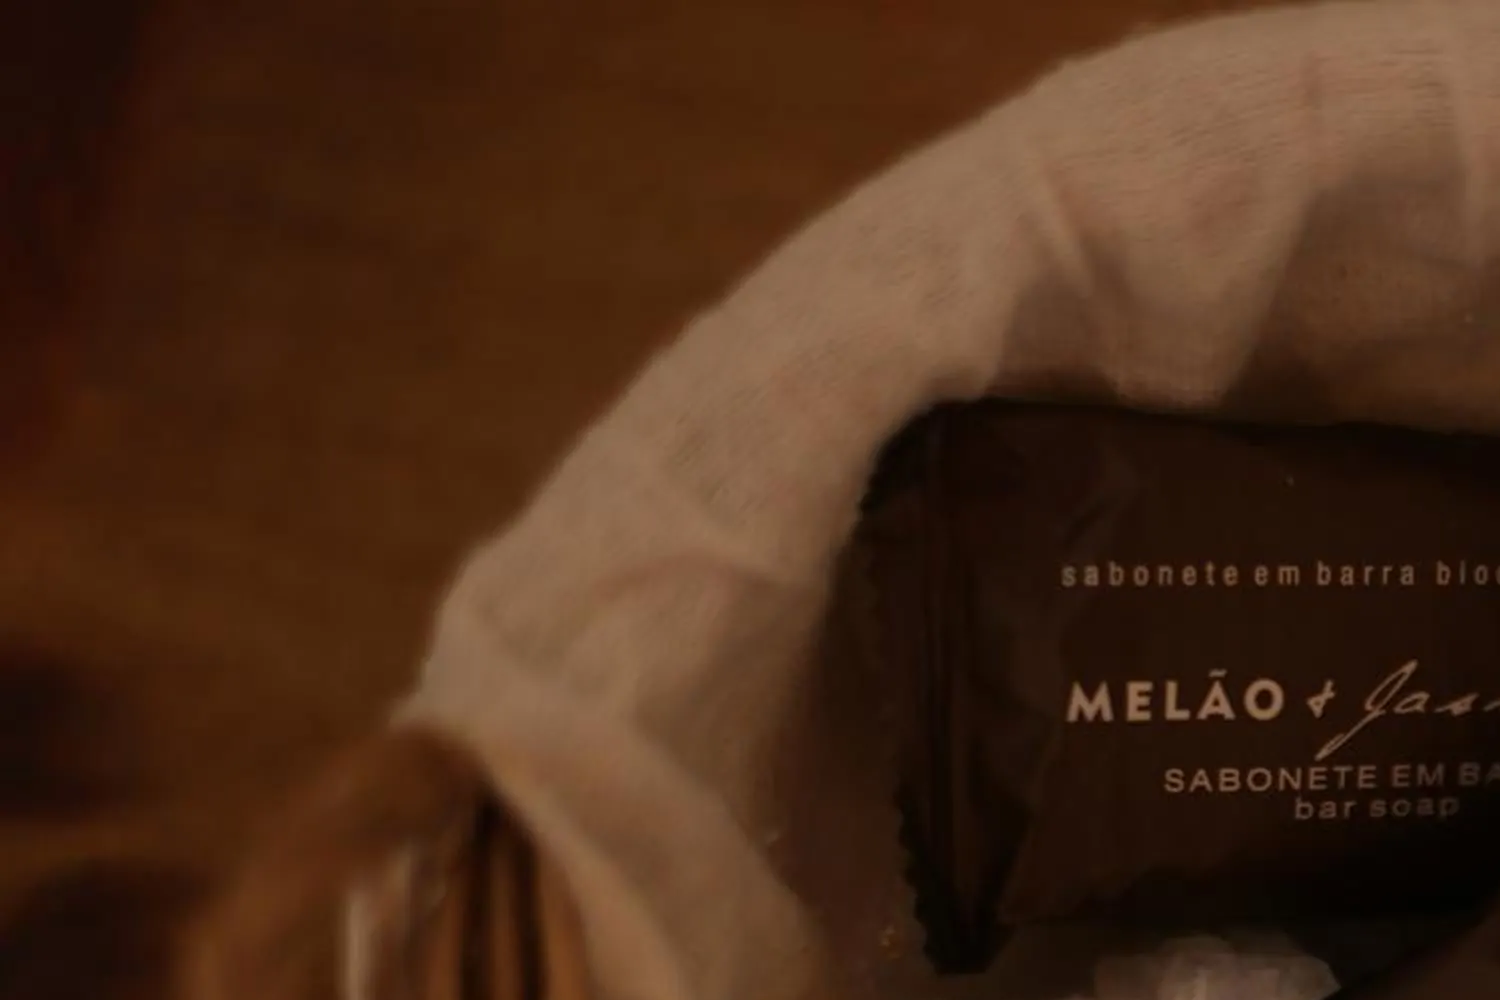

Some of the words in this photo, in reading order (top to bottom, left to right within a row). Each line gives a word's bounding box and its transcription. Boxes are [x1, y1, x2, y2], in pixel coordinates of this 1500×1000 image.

[1061, 559, 1239, 588] sabonete
[1254, 564, 1301, 588] em
[1315, 559, 1416, 588] barra
[1065, 668, 1286, 723] MELÃO
[1163, 764, 1378, 794] SABONETE
[1390, 763, 1445, 790] EM
[1294, 796, 1356, 820] bar
[1368, 796, 1461, 823] soap
